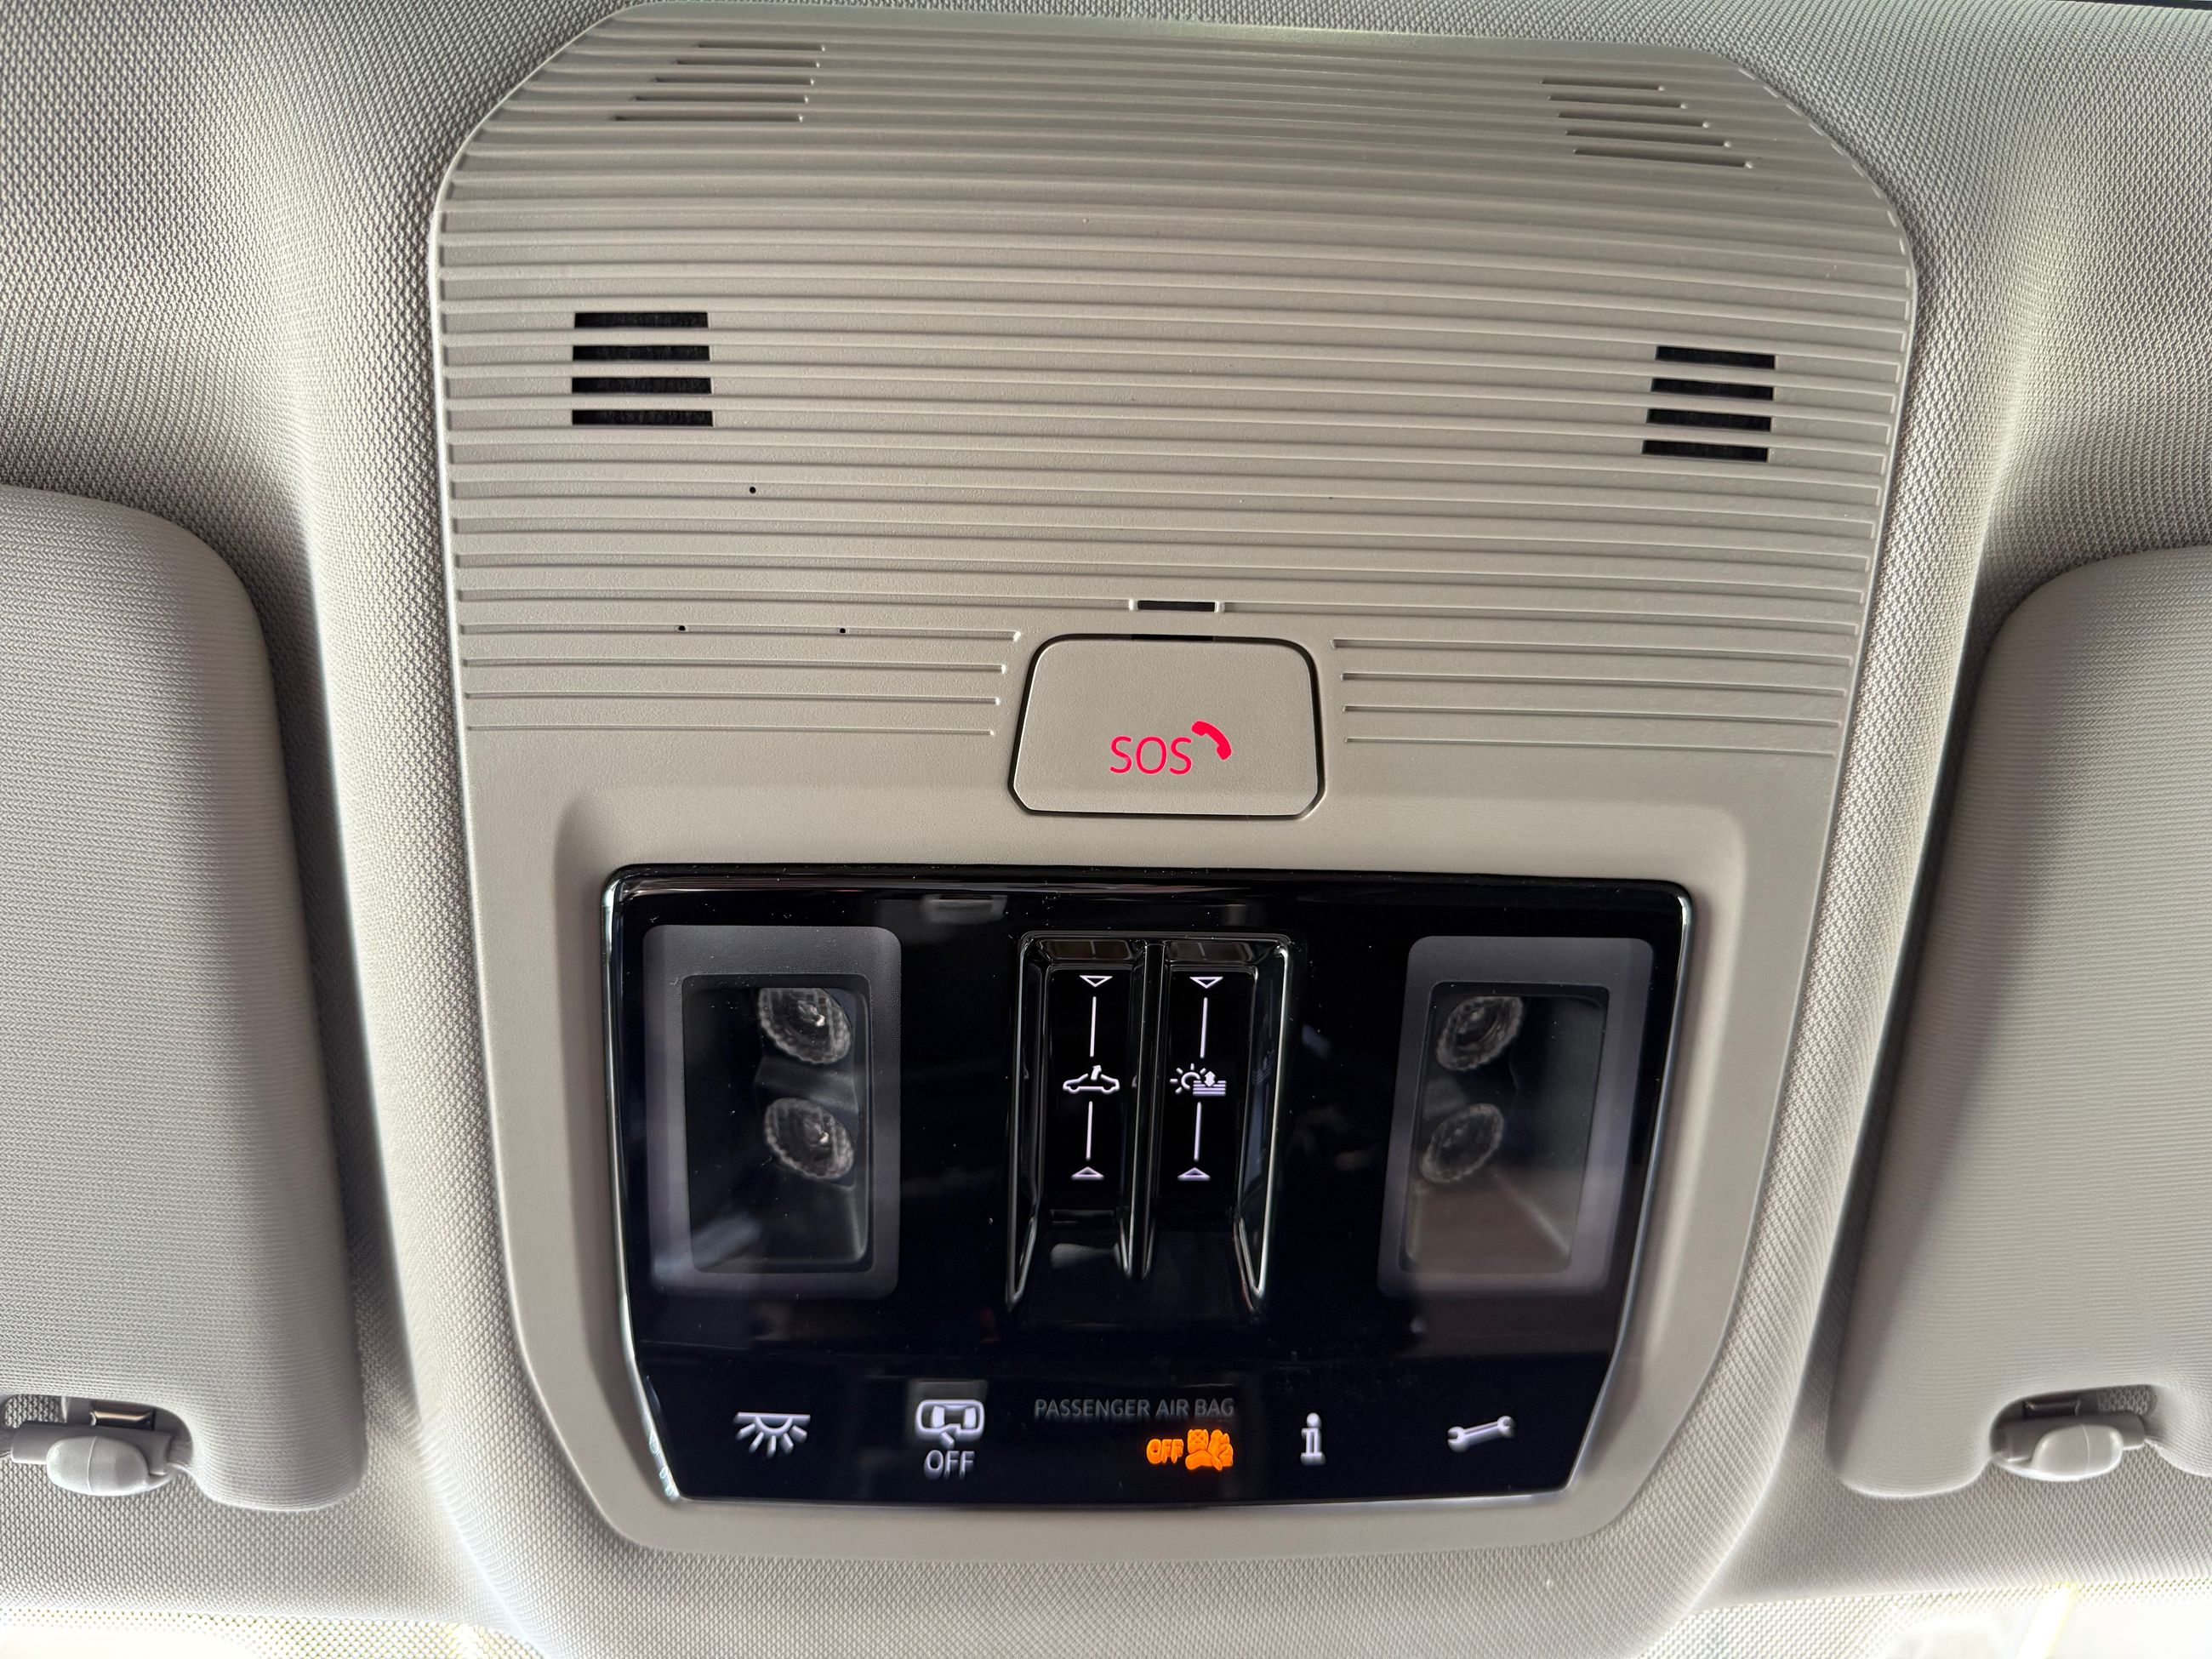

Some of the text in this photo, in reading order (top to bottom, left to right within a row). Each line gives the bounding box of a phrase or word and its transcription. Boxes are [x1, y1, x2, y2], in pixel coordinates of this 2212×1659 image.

[1109, 736, 1192, 774] SOS
[1034, 1397, 1234, 1417] PASSENGER AIR BAG
[925, 1449, 975, 1479] OFF
[1146, 1438, 1184, 1464] OFF
